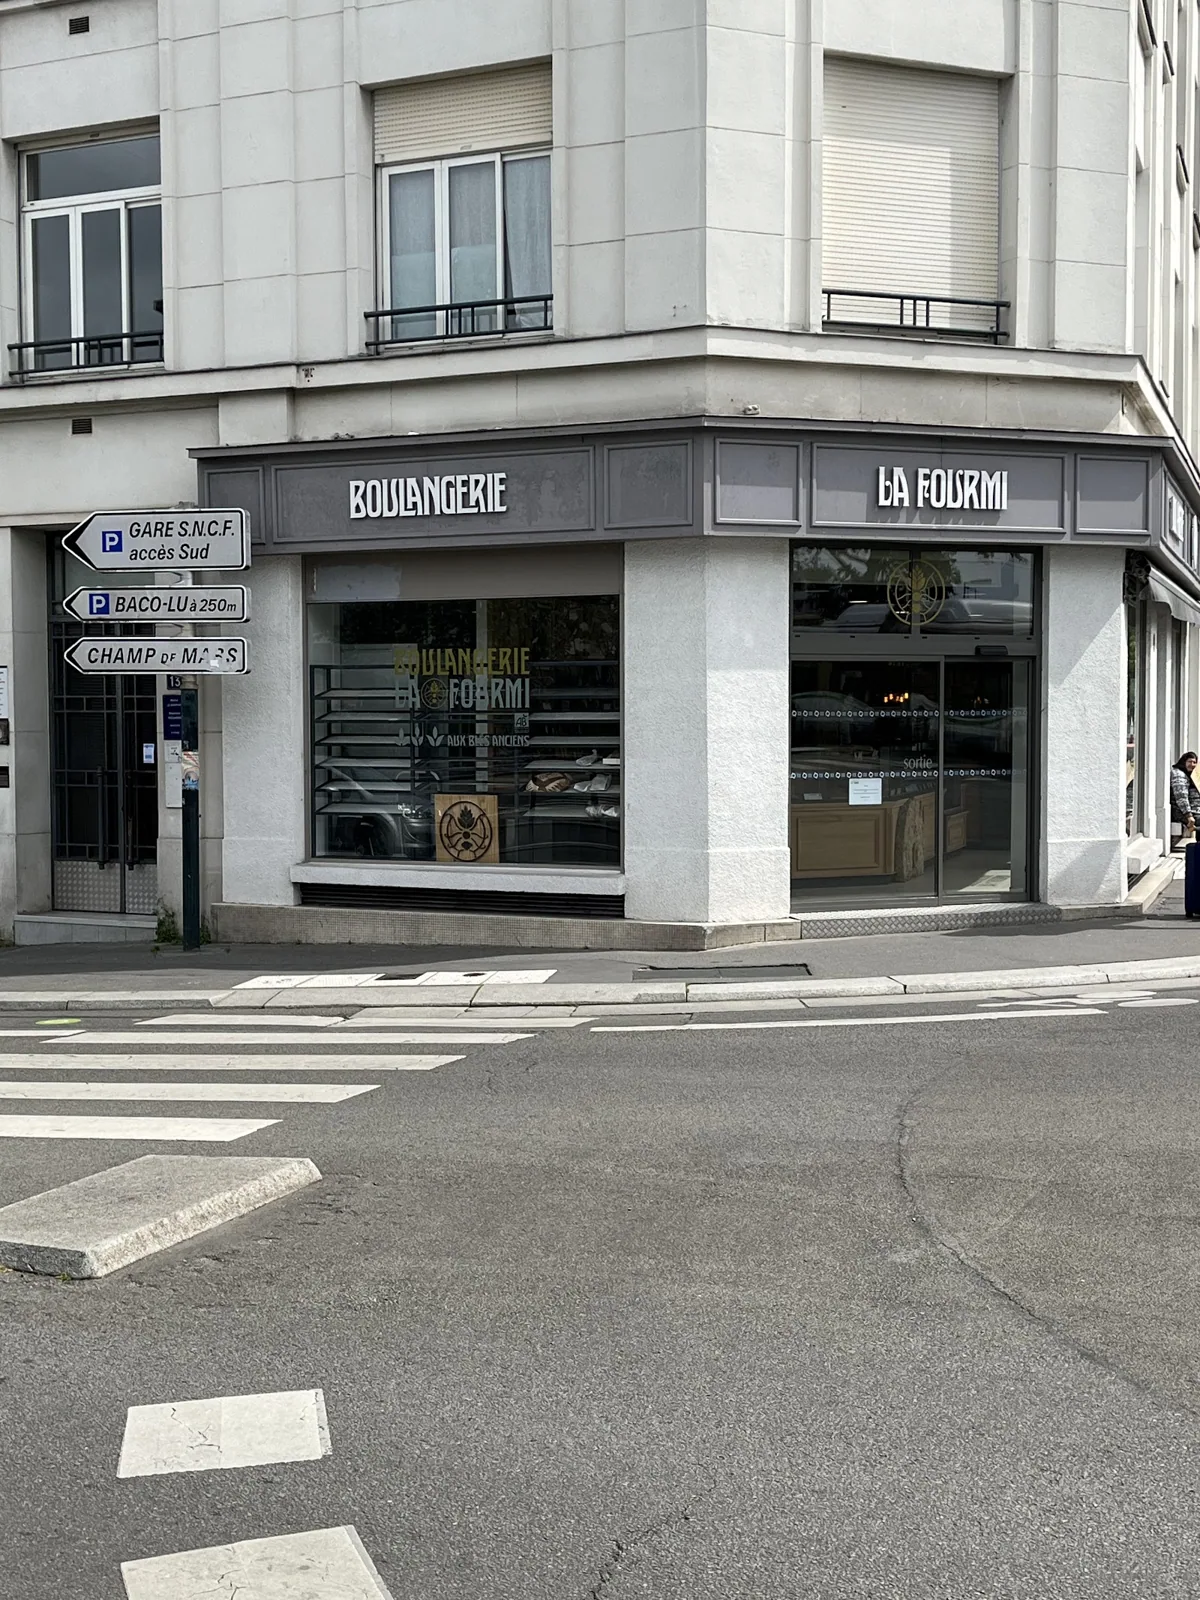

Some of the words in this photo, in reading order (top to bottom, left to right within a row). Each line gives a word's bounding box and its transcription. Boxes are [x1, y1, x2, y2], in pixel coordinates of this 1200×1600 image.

[349, 472, 507, 519] BOULANGERIE
[878, 466, 910, 507] LA
[917, 468, 1008, 511] FOURMI
[129, 521, 175, 538] GARE
[178, 520, 235, 537] S.N.C.F.
[105, 532, 119, 552] P
[129, 544, 175, 561] accès
[178, 543, 210, 560] Sud
[92, 595, 106, 614] P
[115, 596, 188, 613] BACO-LU
[189, 598, 197, 613] à
[199, 599, 237, 613] 250m
[87, 647, 156, 664] CHAMP
[394, 647, 531, 676] BOULANGERIE
[170, 675, 181, 687] 13
[395, 677, 421, 709] LA
[450, 677, 531, 709] FOURMI
[447, 734, 466, 747] AUX
[492, 734, 531, 747] ANCIENS
[903, 754, 933, 770] sortie
